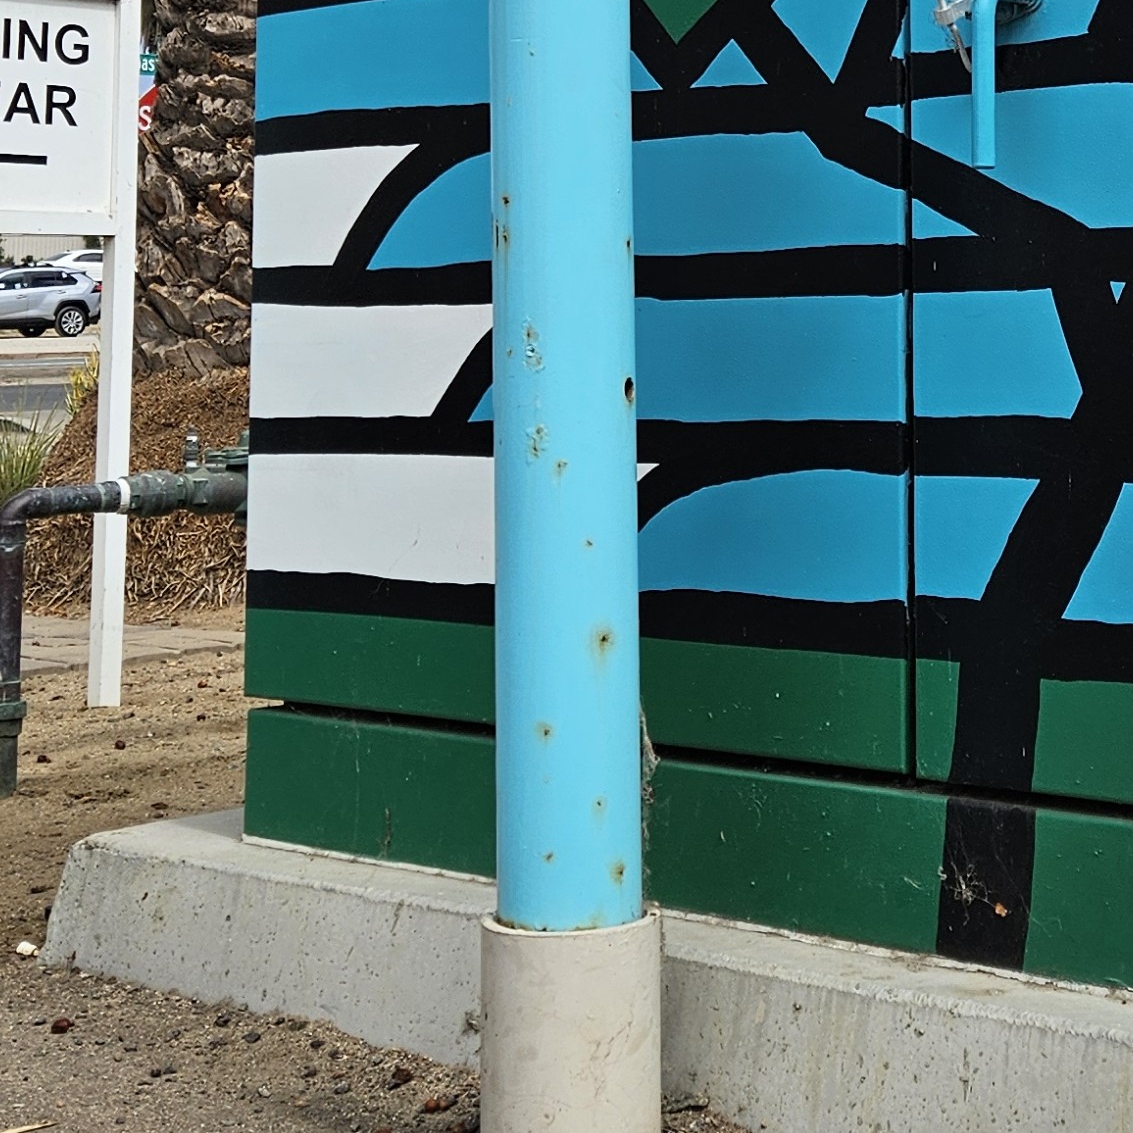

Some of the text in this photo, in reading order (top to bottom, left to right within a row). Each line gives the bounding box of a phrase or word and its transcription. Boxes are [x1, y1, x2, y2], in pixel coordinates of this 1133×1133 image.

[2, 18, 90, 65] ING
[141, 58, 158, 72] as
[0, 81, 79, 128] AR
